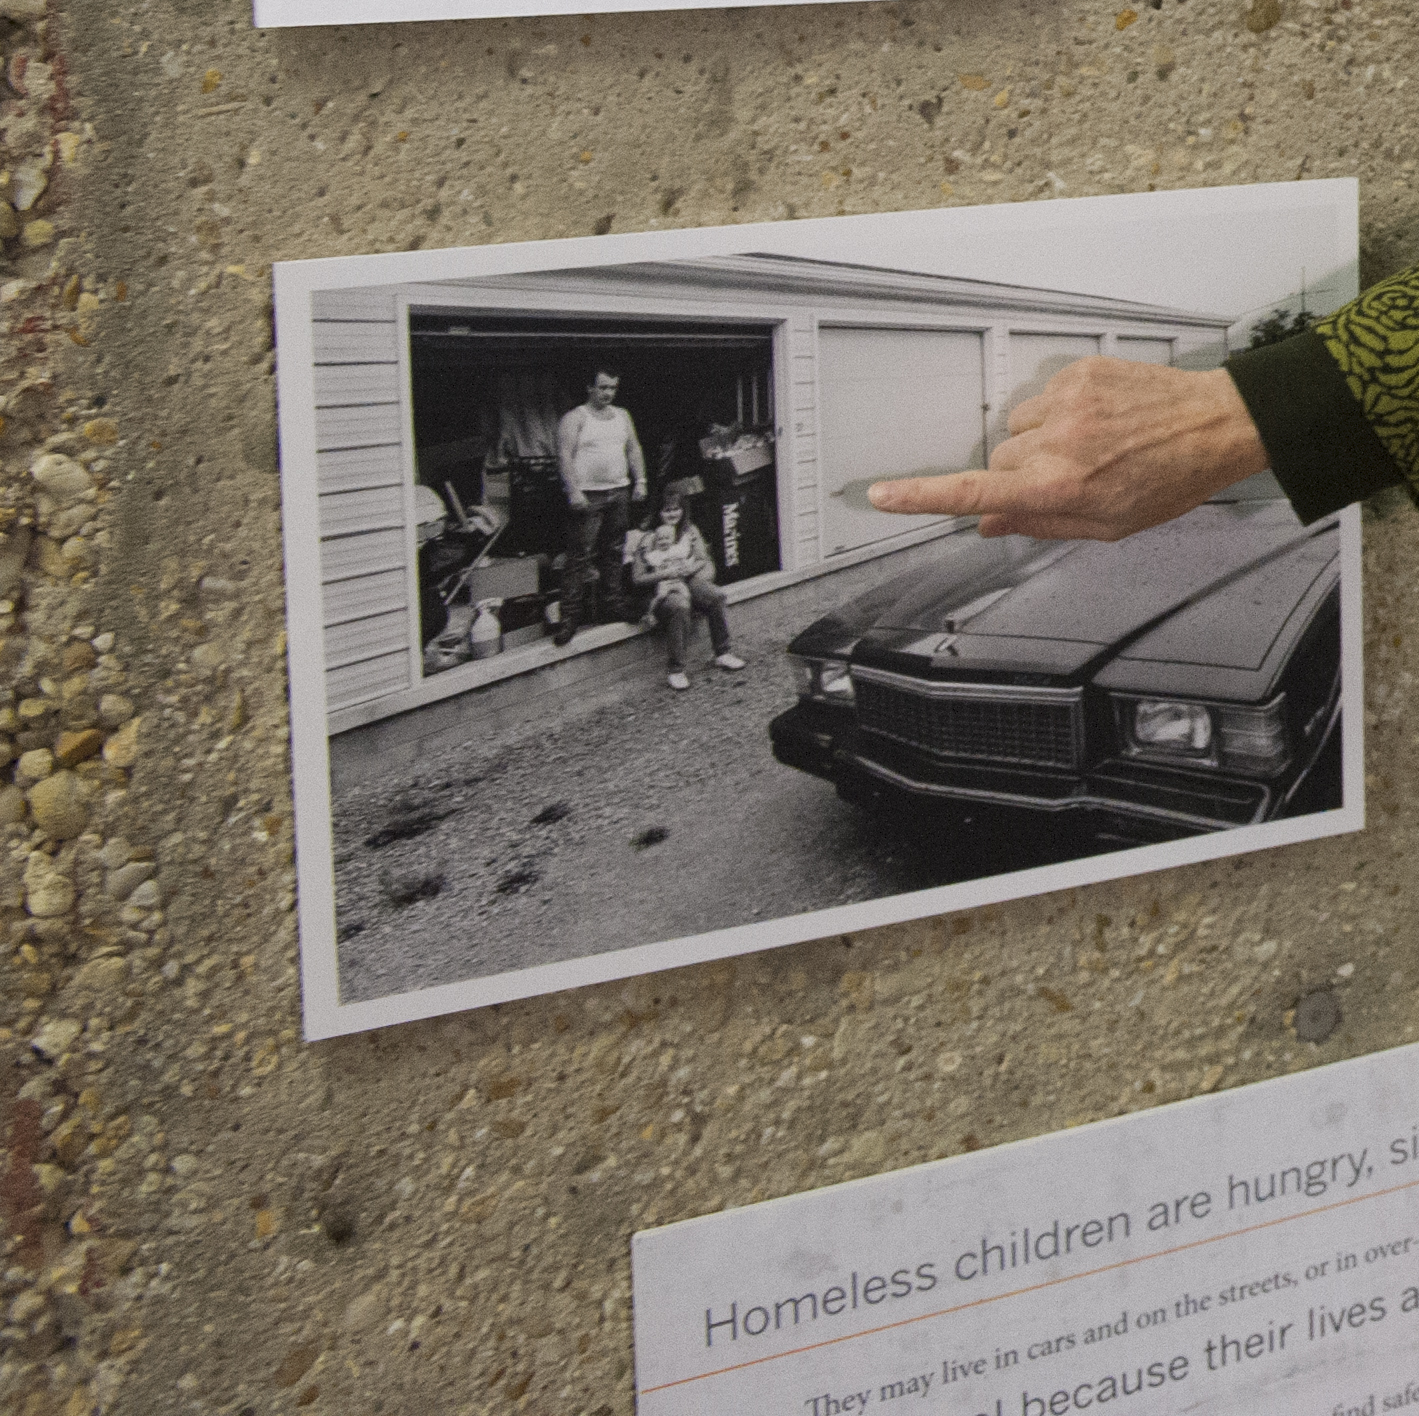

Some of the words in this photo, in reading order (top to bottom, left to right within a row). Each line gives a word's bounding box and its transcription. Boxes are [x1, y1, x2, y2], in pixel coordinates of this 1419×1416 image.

[722, 502, 741, 567] Marines
[705, 1261, 939, 1347] Homeless
[954, 1210, 1132, 1281] children
[1146, 1189, 1212, 1232] are
[1227, 1147, 1375, 1209] hungry,
[804, 1389, 872, 1416] They
[879, 1371, 936, 1403] may
[941, 1357, 988, 1384] live
[994, 1347, 1020, 1370] in
[1026, 1328, 1077, 1360] cars
[1083, 1312, 1129, 1346] and
[1136, 1304, 1168, 1330] on
[1174, 1292, 1211, 1320] the
[1218, 1267, 1299, 1307] streets,
[1304, 1258, 1330, 1282] or
[1336, 1249, 1358, 1274] in
[1021, 1354, 1191, 1416] because
[1203, 1319, 1294, 1372] their
[1307, 1294, 1387, 1341] lives
